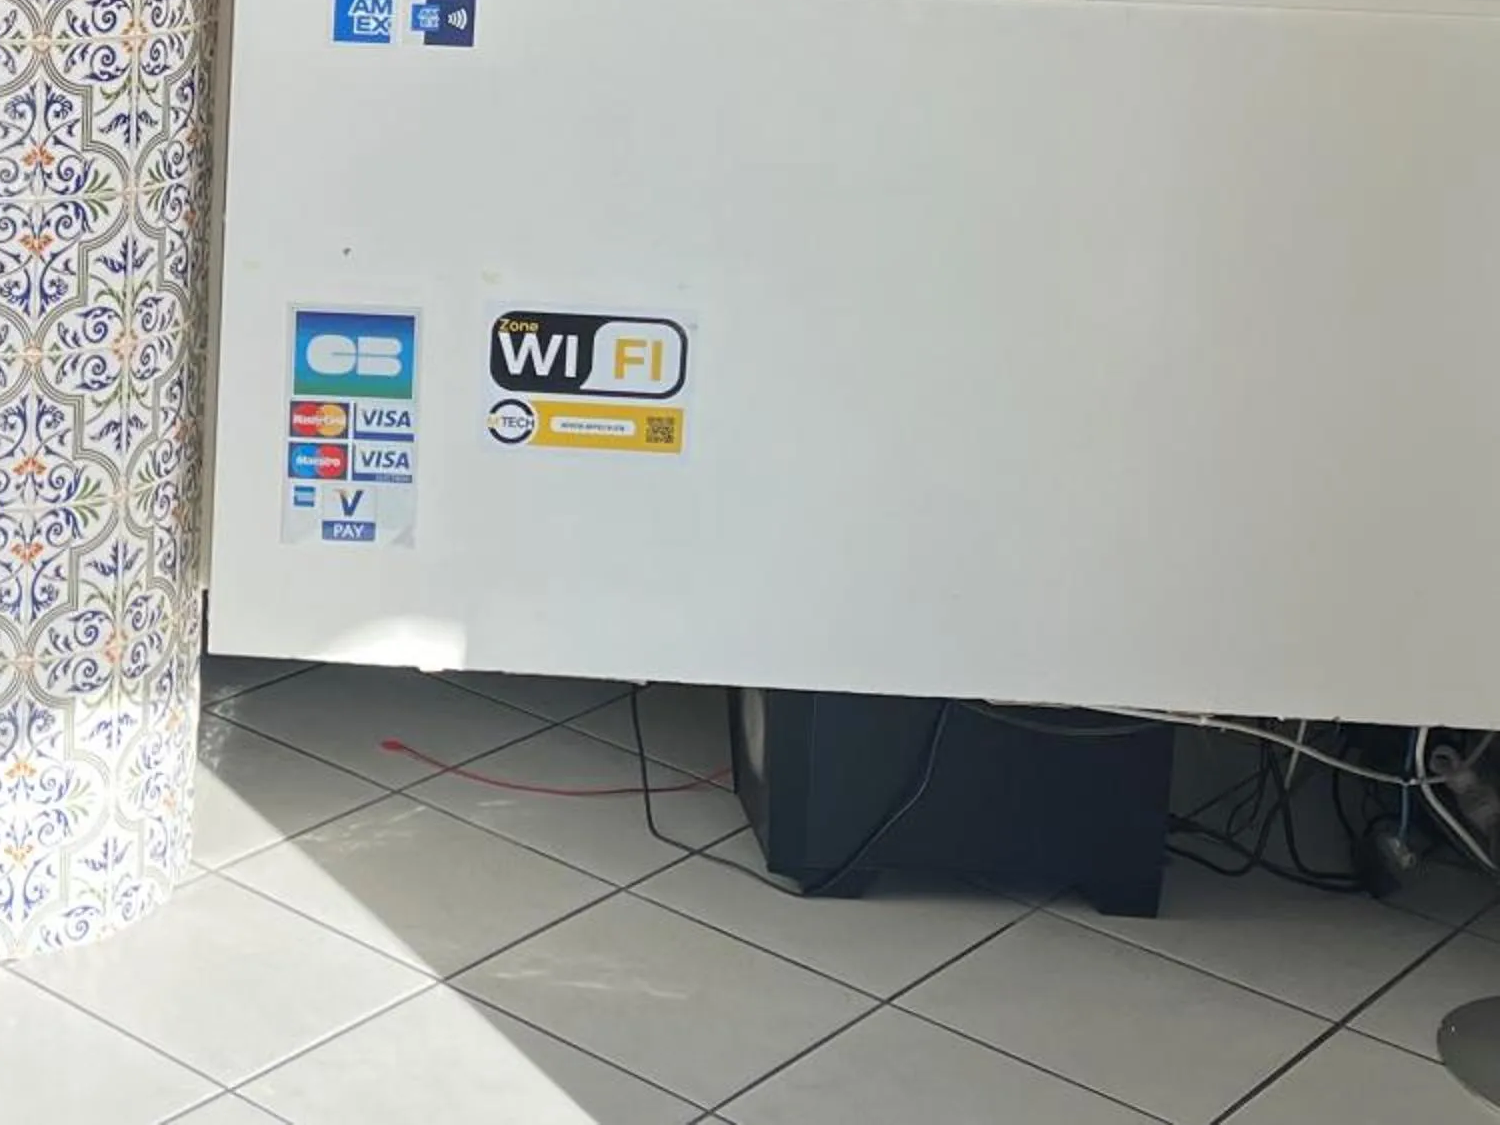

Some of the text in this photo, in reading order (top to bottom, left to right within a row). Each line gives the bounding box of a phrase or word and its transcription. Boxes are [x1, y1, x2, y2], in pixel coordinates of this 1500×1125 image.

[355, 15, 392, 35] EX
[500, 318, 540, 332] Zone
[306, 334, 403, 376] CB
[498, 331, 663, 381] WI FI
[362, 410, 412, 428] VISA
[360, 451, 410, 470] VISA
[338, 489, 364, 517] V
[332, 522, 364, 538] PAY
